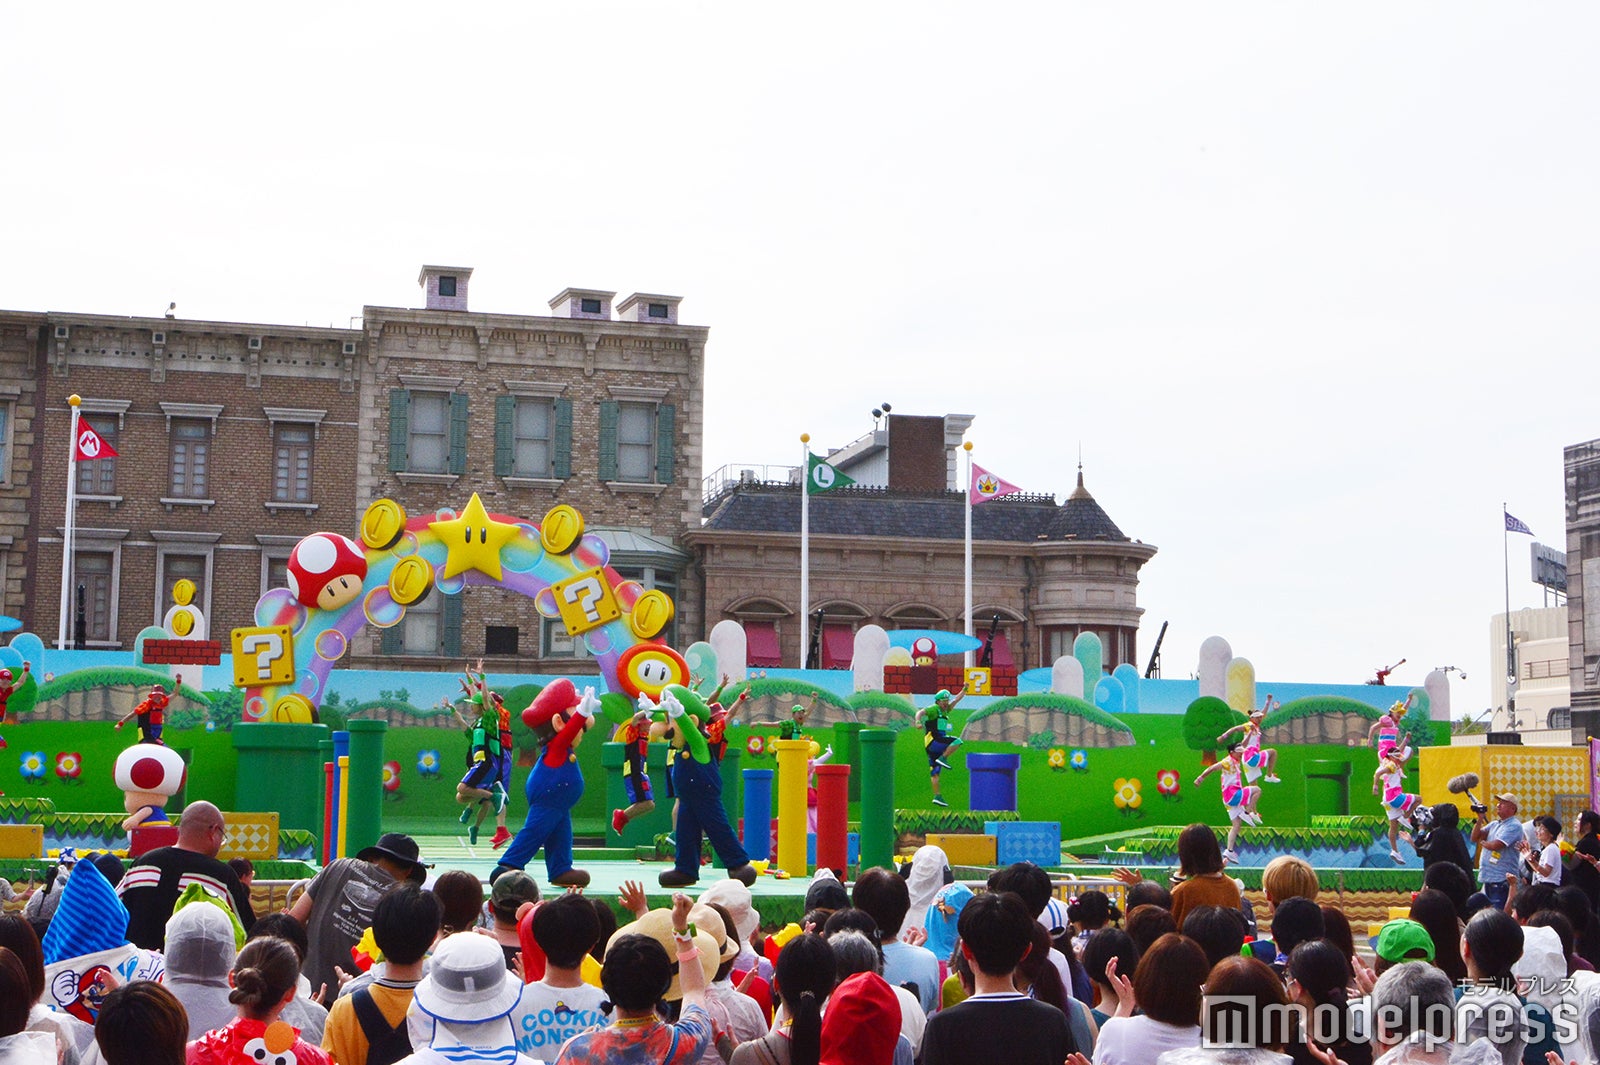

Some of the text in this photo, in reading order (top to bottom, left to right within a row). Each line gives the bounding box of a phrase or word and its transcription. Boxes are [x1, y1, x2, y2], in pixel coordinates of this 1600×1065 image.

[81, 434, 98, 452] M
[818, 466, 829, 484] L
[516, 1027, 583, 1053] MONS
